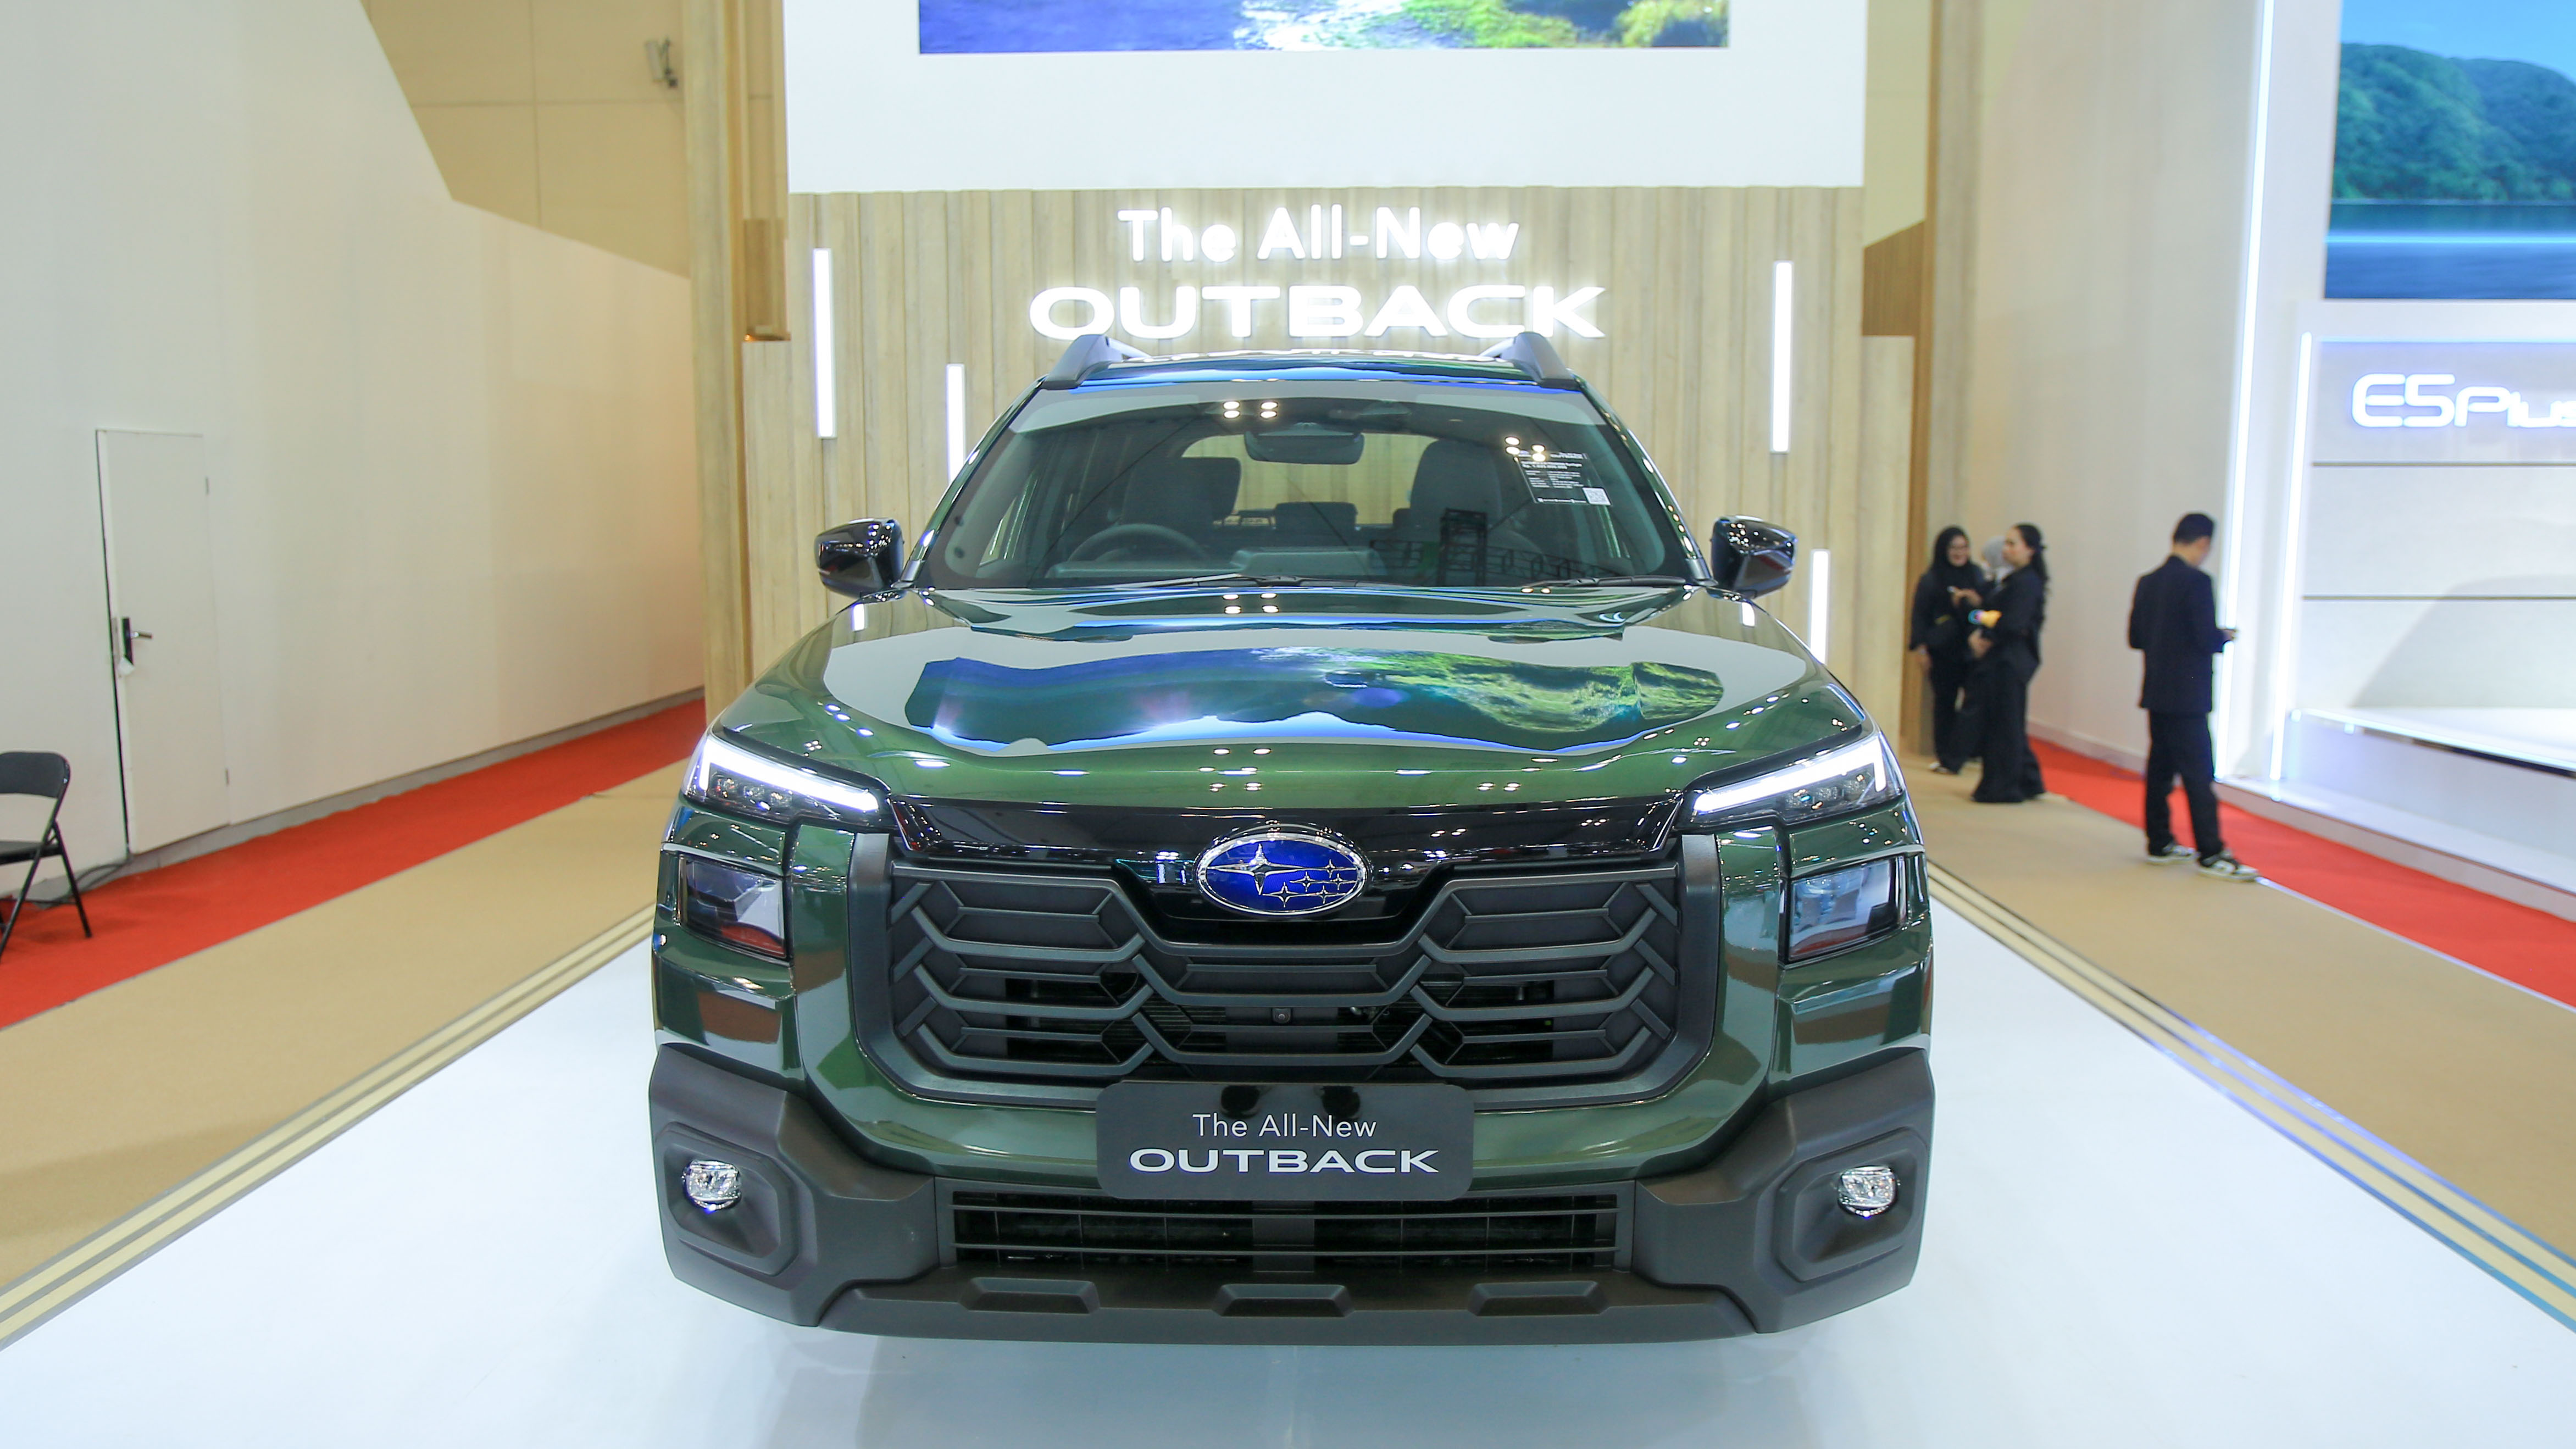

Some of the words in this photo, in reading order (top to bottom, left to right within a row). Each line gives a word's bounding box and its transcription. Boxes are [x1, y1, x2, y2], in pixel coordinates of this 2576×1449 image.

[1118, 207, 1236, 262] The
[1257, 204, 1519, 259] All-New
[1029, 285, 1606, 339] OUTBACK
[1192, 1113, 1247, 1137] The
[1259, 1113, 1377, 1137] All-New
[1129, 1148, 1439, 1174] OUTBACK
